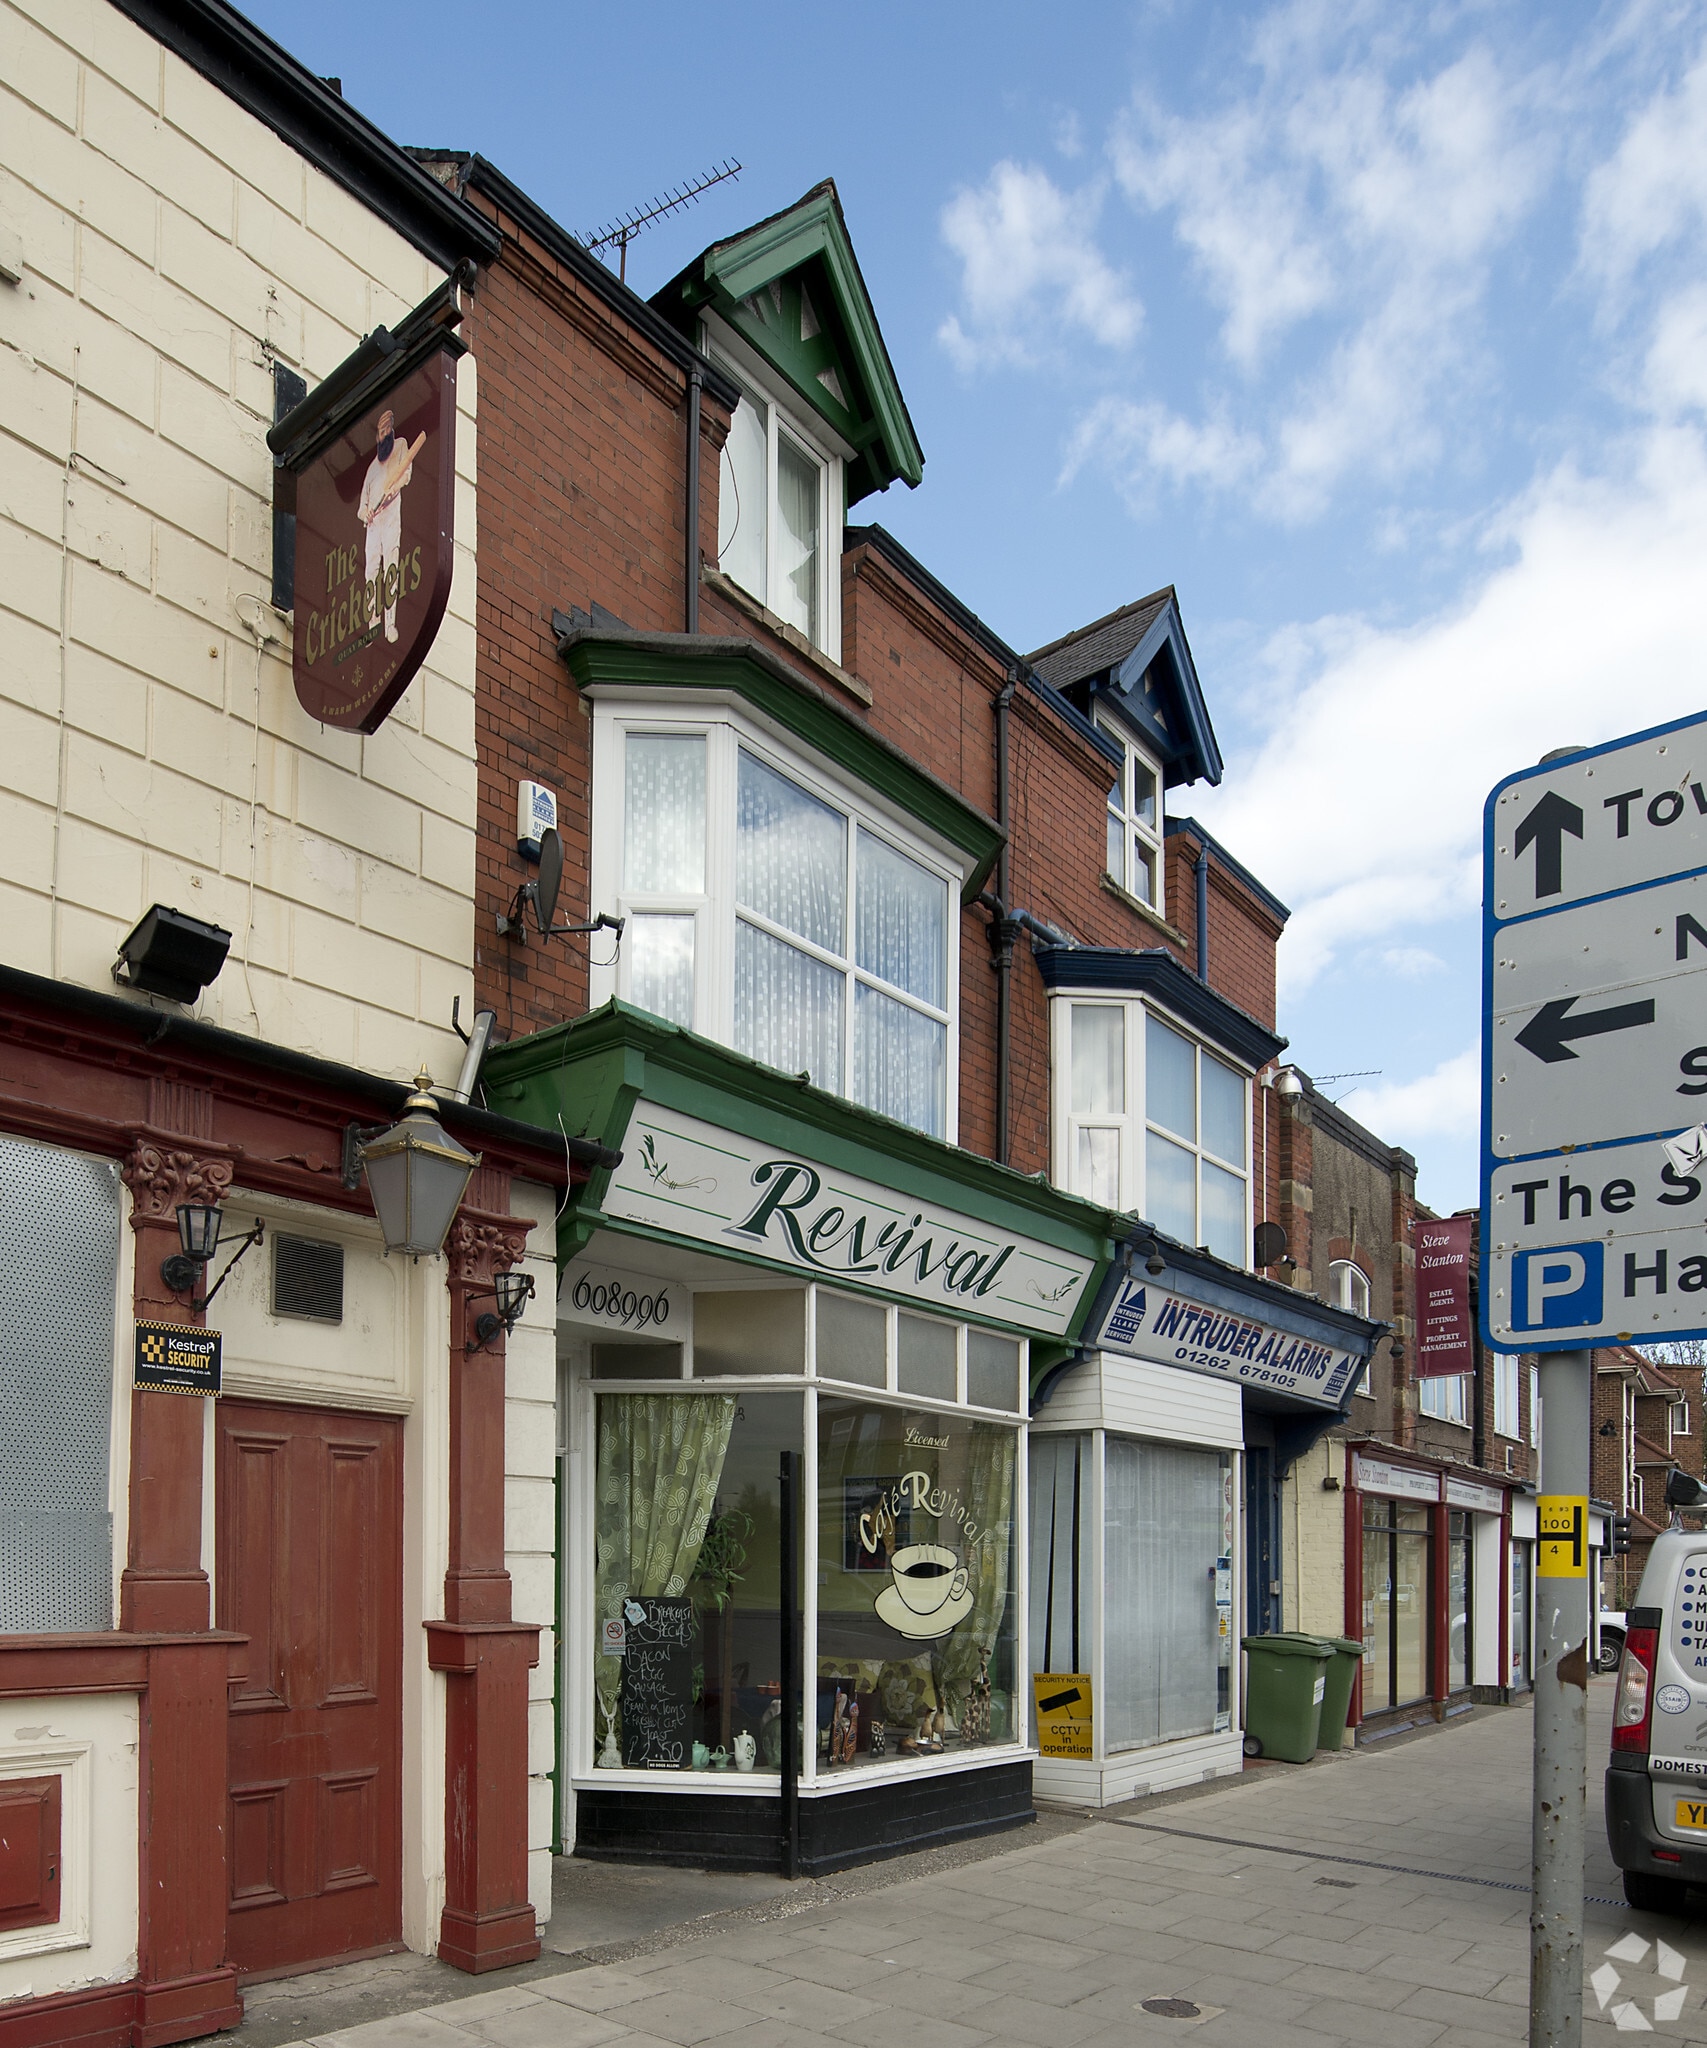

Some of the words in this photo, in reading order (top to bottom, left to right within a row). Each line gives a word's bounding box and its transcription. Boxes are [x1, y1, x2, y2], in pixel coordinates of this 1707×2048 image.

[325, 543, 358, 594] The
[305, 545, 421, 666] Cricketers
[355, 660, 397, 708] WELCOME
[1512, 1175, 1636, 1226] The
[723, 1160, 1015, 1299] Revival
[1421, 1235, 1450, 1249] Steve
[1420, 1253, 1464, 1269] Stanton
[572, 1271, 669, 1331] 608996
[1429, 1288, 1453, 1298] ESTATE
[1429, 1297, 1454, 1307] AGENTS
[1112, 1317, 1139, 1330] ALARM
[1427, 1315, 1458, 1325] LETTINGS
[1106, 1329, 1133, 1342] SERVICES
[1152, 1297, 1264, 1360] INTRUDER
[1255, 1332, 1333, 1380] ALARMS
[1426, 1333, 1460, 1343] PROPERTY
[168, 1338, 210, 1354] Kestrel
[1420, 1341, 1468, 1352] MANAGEMENT
[168, 1351, 211, 1368] SECURITY
[1175, 1347, 1231, 1371] 01262
[1239, 1365, 1297, 1388] 678105
[904, 1427, 950, 1447] Licensed
[860, 1486, 902, 1554] Café
[900, 1471, 987, 1548] Revival
[1543, 1519, 1570, 1529] 100
[1550, 1545, 1559, 1555] 4
[1694, 1620, 1707, 1632] U
[626, 1644, 670, 1672] BACON
[626, 1675, 677, 1702] SAUSAGE
[1051, 1725, 1080, 1735] CCTV
[1062, 1734, 1071, 1743] in
[1043, 1744, 1092, 1754] operation
[1688, 1804, 1707, 1825] Y
